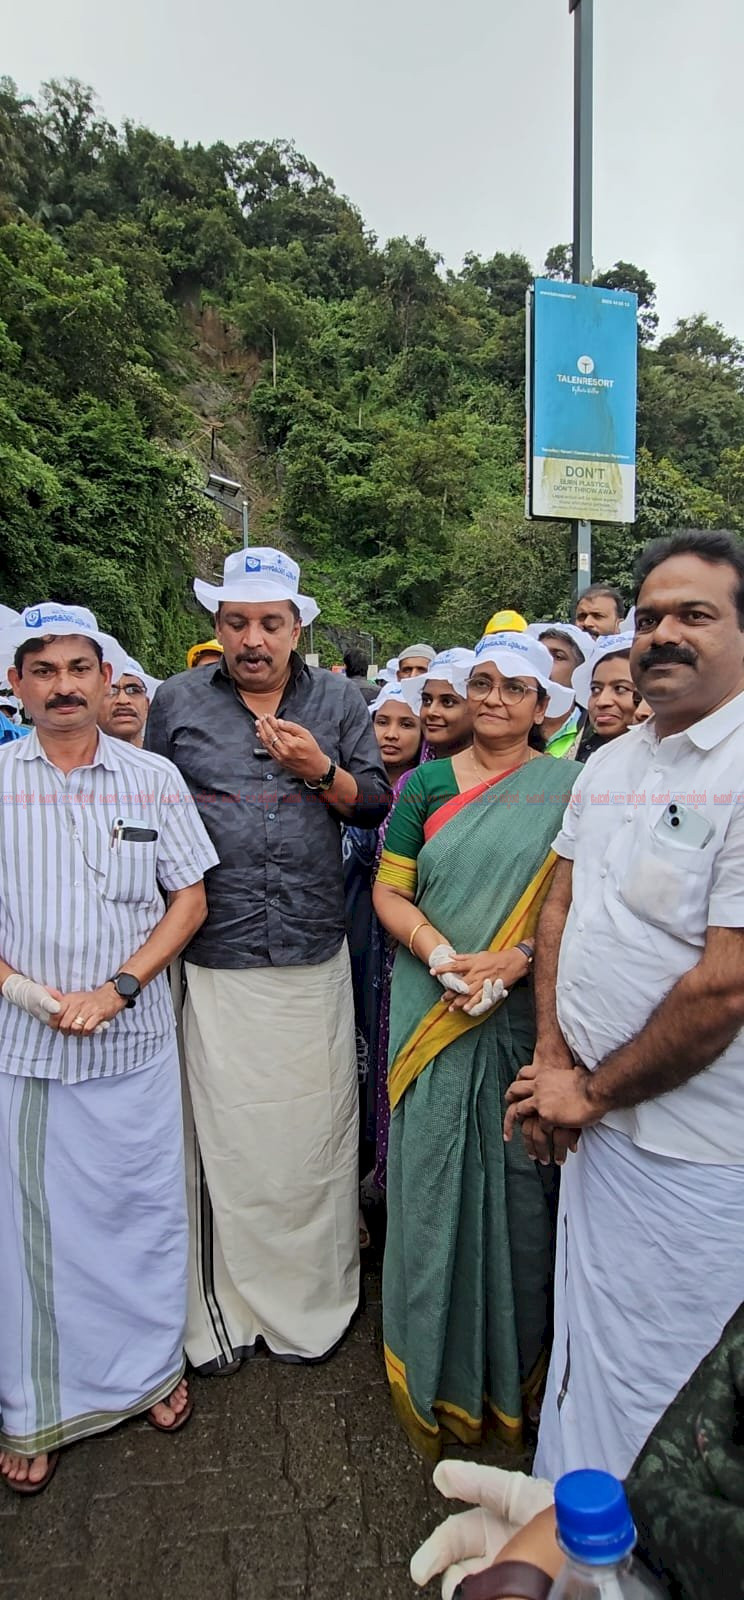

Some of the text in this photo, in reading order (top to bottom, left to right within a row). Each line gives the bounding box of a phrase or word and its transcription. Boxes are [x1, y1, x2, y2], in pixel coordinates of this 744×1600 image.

[565, 466, 606, 480] DON'T
[579, 480, 610, 489] PLASTICS
[574, 486, 597, 494] THROW
